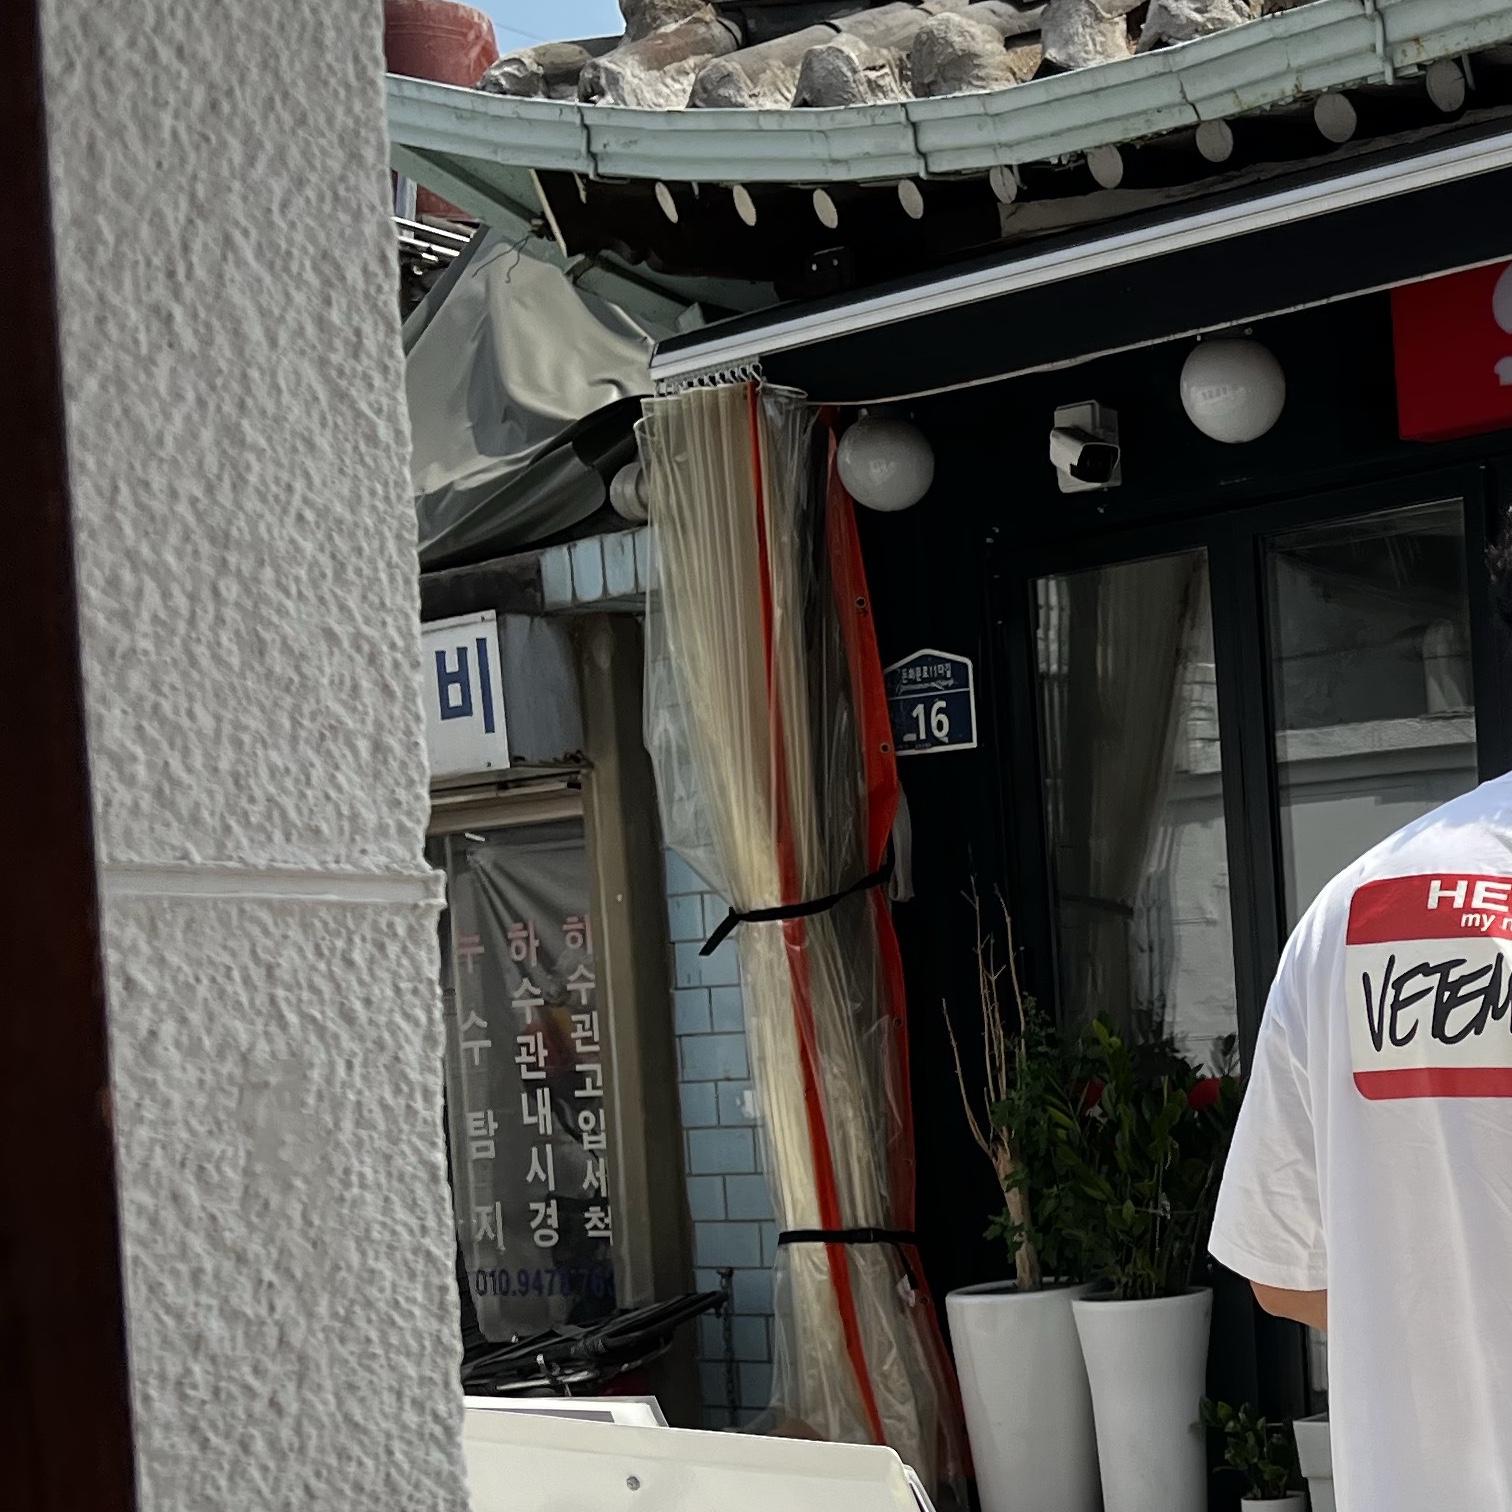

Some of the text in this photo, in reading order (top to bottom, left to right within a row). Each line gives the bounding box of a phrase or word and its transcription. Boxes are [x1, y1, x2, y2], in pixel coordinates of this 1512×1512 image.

[435, 637, 495, 734] 비
[911, 699, 950, 742] 16
[1461, 913, 1495, 933] my
[457, 934, 506, 1252] 누수탐지
